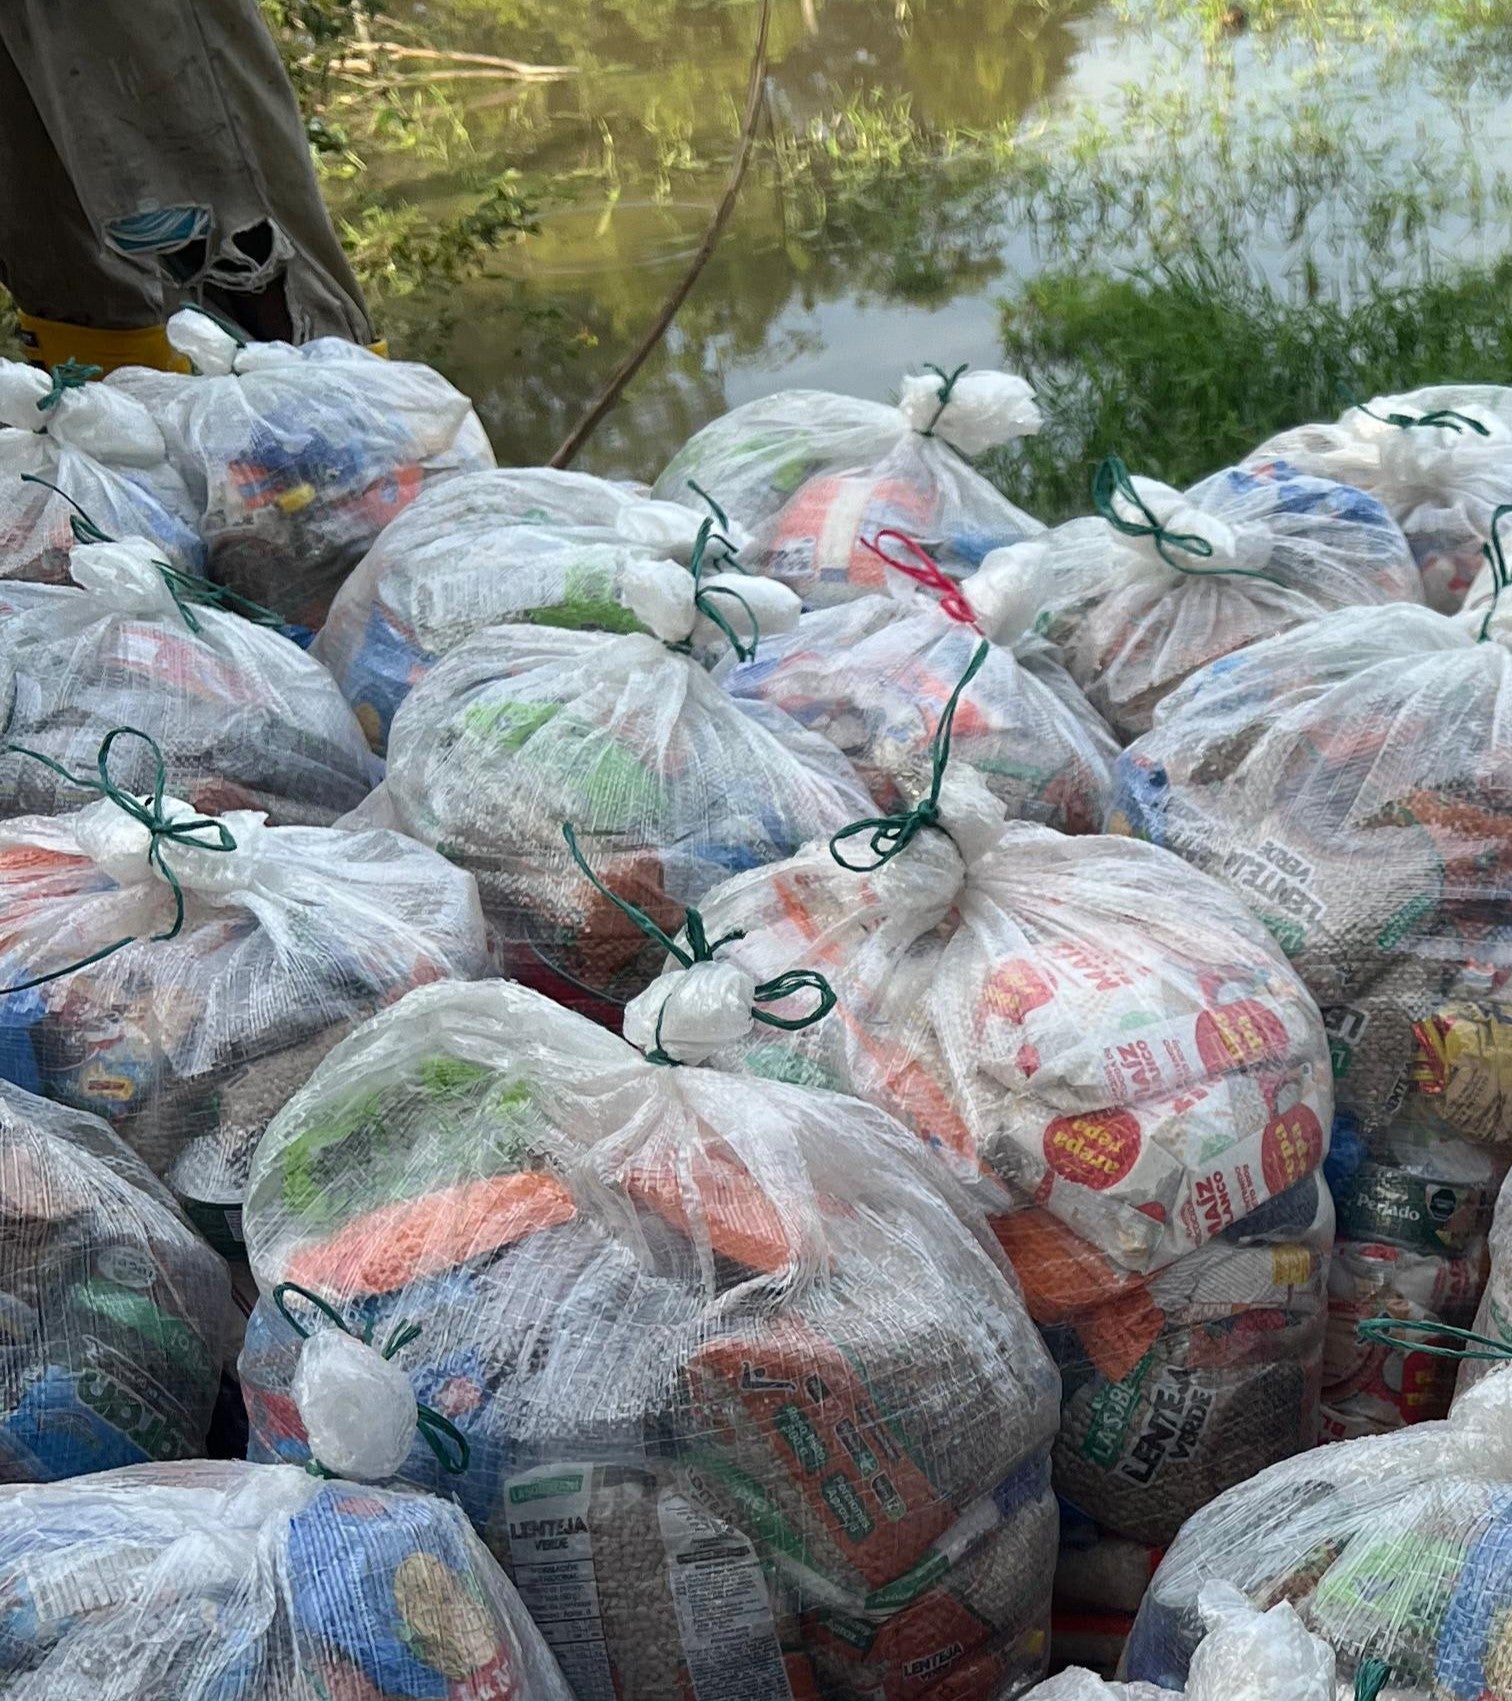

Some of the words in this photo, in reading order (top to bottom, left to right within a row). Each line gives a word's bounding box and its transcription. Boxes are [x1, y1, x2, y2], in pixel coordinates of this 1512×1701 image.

[1053, 1131, 1120, 1174] arepa
[1072, 1119, 1126, 1153] repa
[1212, 1170, 1234, 1227] LANCO
